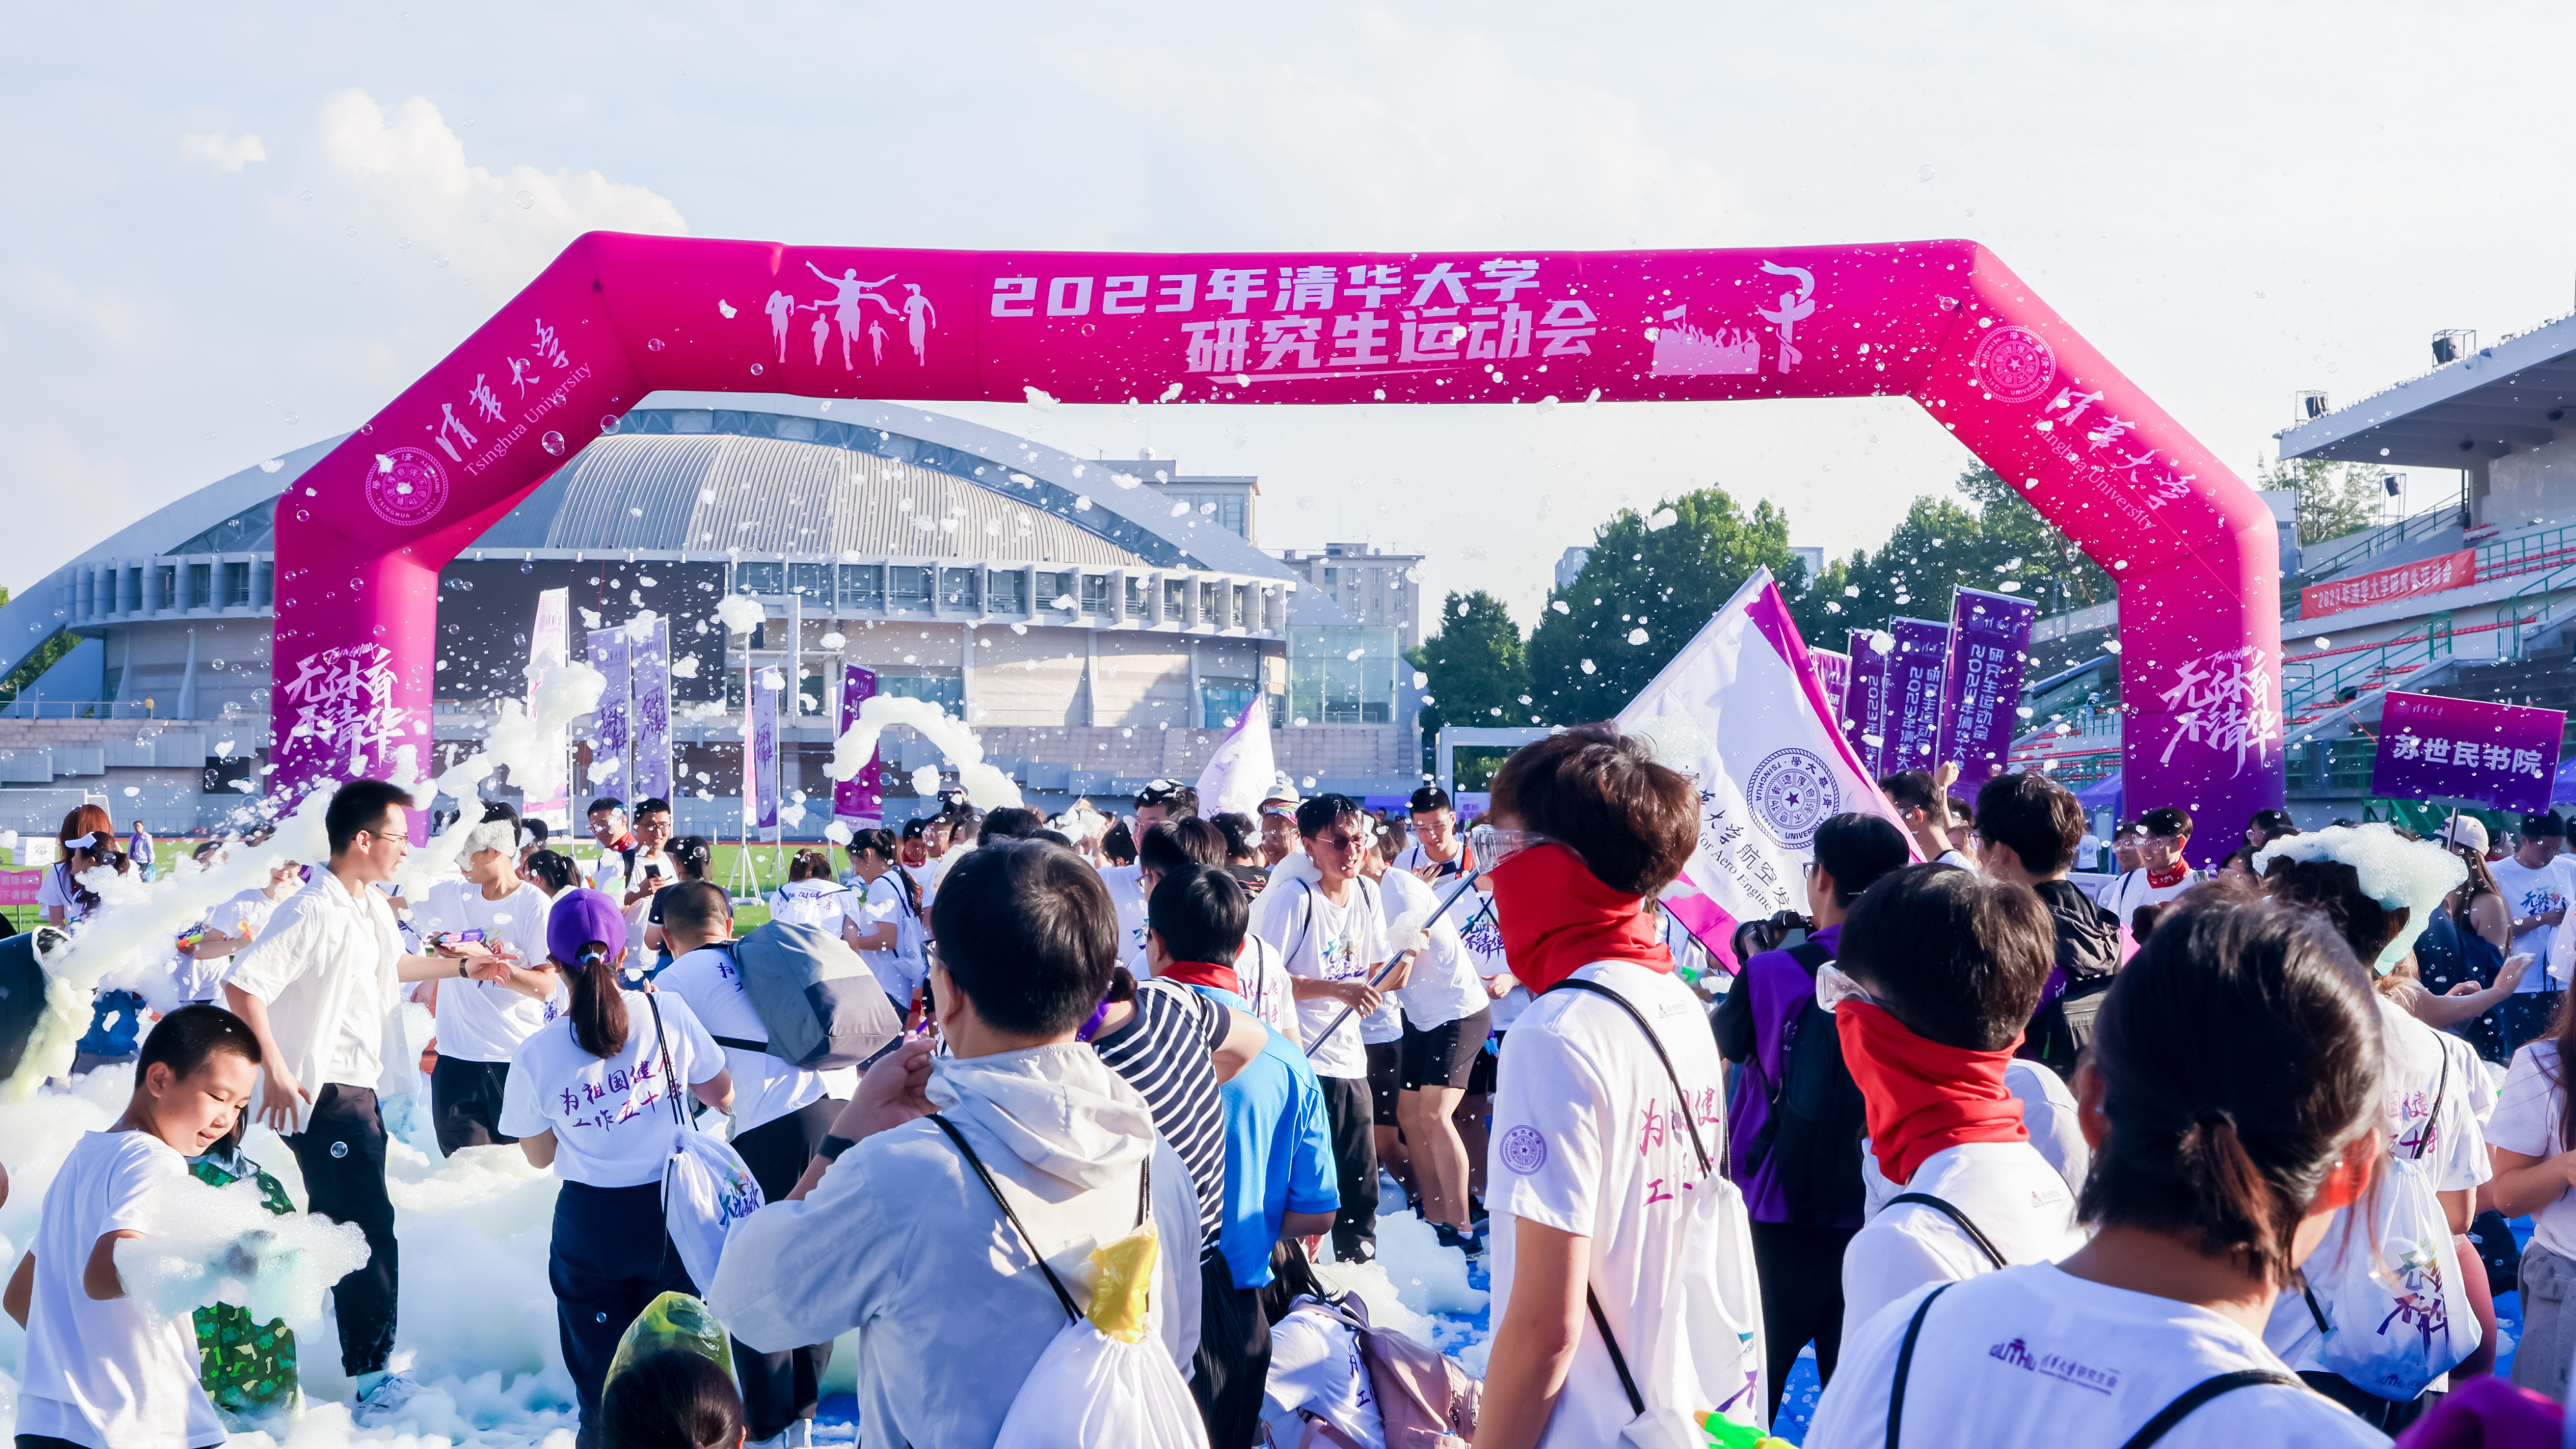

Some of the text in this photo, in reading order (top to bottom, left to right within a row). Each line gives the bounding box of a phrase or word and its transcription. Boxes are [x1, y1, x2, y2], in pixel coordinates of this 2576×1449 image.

[990, 260, 1540, 317] 2023年清华大学
[1181, 300, 1598, 374] 研究生运动会
[464, 361, 592, 477] Tsinghua University
[2029, 415, 2157, 531] Tsinghua University
[377, 497, 410, 518] TSINGHUA
[2318, 560, 2452, 608] 2023年清华大学研究生运动会
[284, 647, 398, 710] 无体育
[1973, 647, 2005, 741] 研究生运动会
[2159, 649, 2272, 716] 无体育
[1896, 666, 1924, 774] 2023年清华大
[2159, 703, 2280, 780] 不清华
[1756, 762, 1783, 802] TSINGHUA
[2392, 734, 2543, 775] 苏世民书院
[1785, 815, 1824, 840] UNIVERSITY
[1710, 849, 1738, 874] Aero
